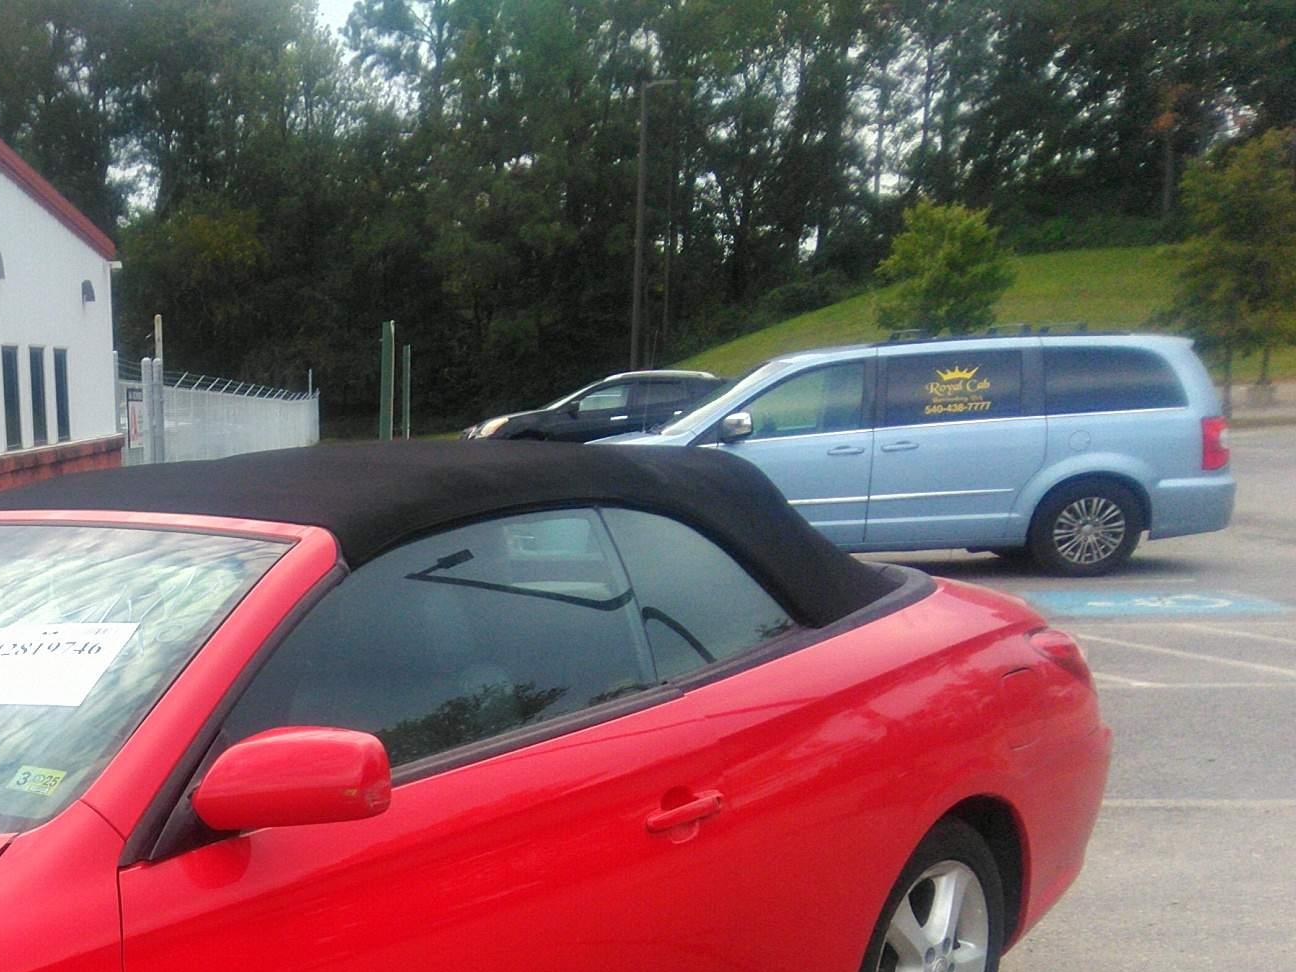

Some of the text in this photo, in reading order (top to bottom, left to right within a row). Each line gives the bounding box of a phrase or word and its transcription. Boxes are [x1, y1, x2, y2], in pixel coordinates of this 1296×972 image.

[926, 378, 991, 396] Royal Cab
[16, 771, 32, 786] 3
